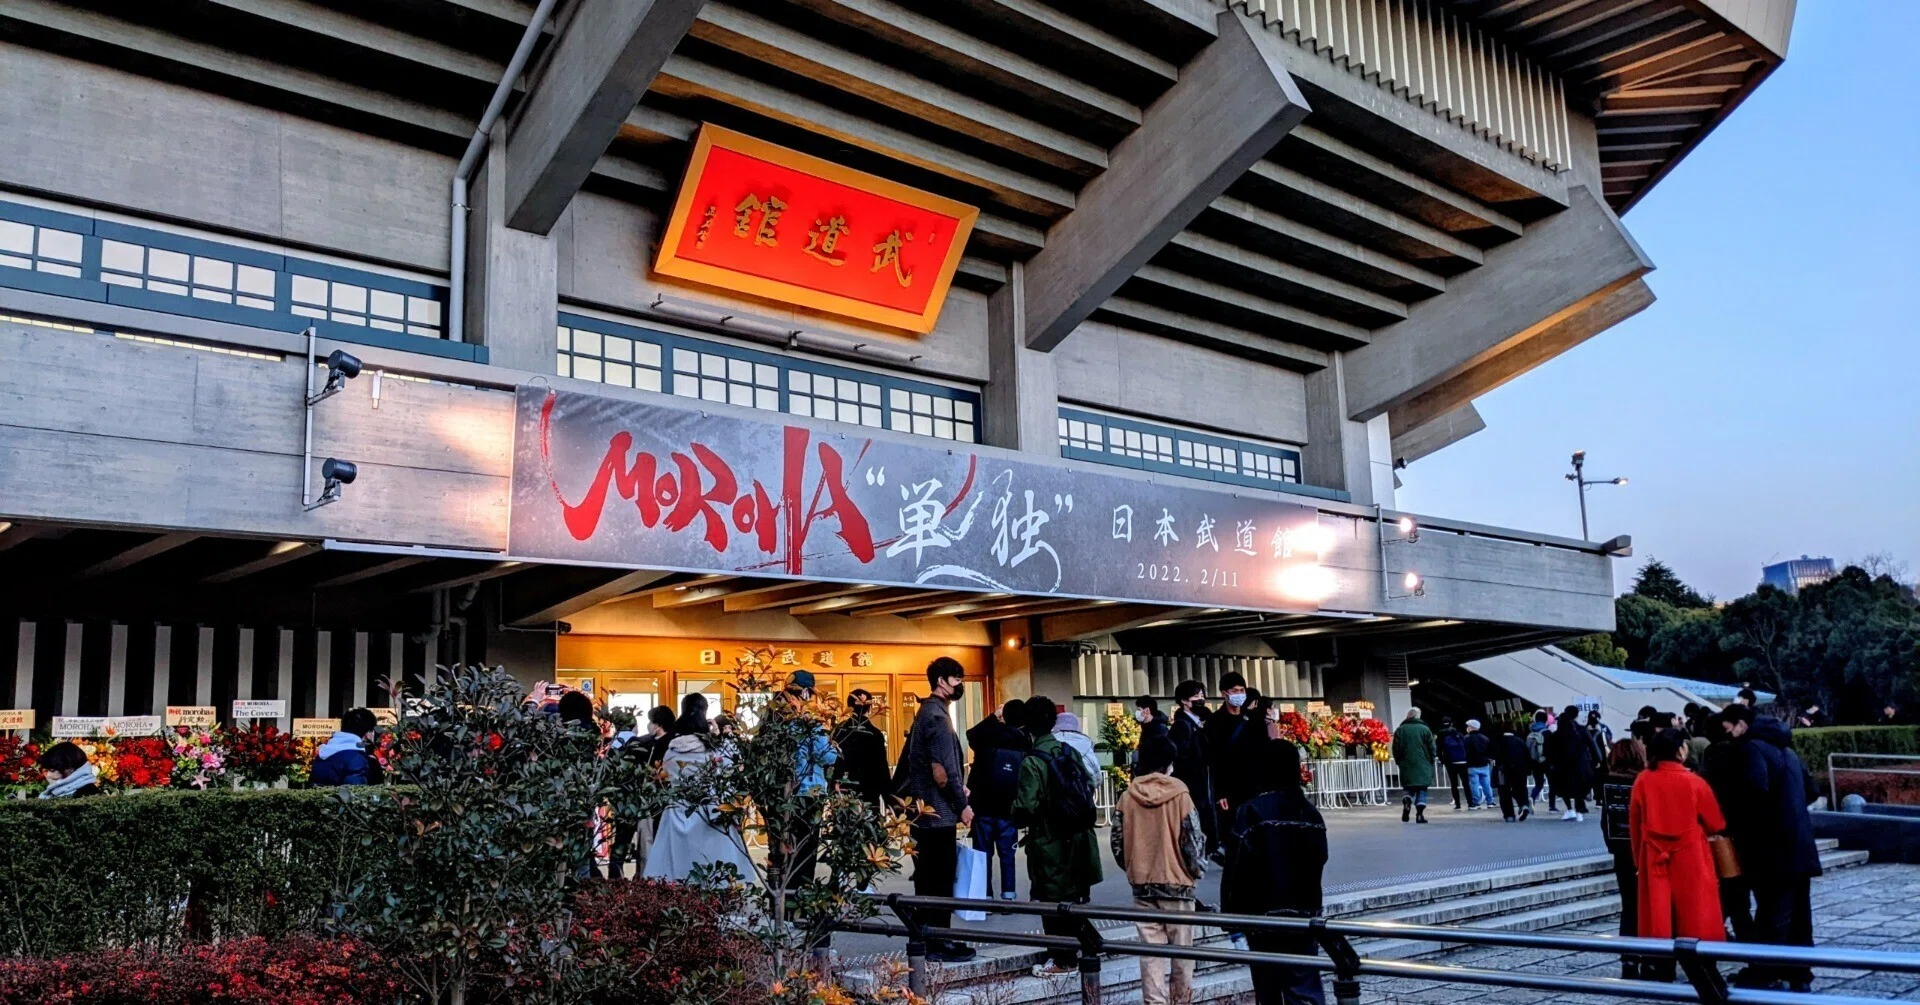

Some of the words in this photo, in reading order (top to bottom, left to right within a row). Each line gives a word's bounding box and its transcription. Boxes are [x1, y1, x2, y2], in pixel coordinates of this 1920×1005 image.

[541, 394, 877, 576] MOROHA
[1111, 503, 1296, 560] 日本武道館
[1137, 562, 1189, 583] 2022.
[1200, 567, 1240, 588] 2/11
[700, 647, 873, 668] 日本武道館
[182, 708, 209, 716] moroha
[60, 723, 95, 731] MOROHA
[113, 721, 148, 729] MOROHA
